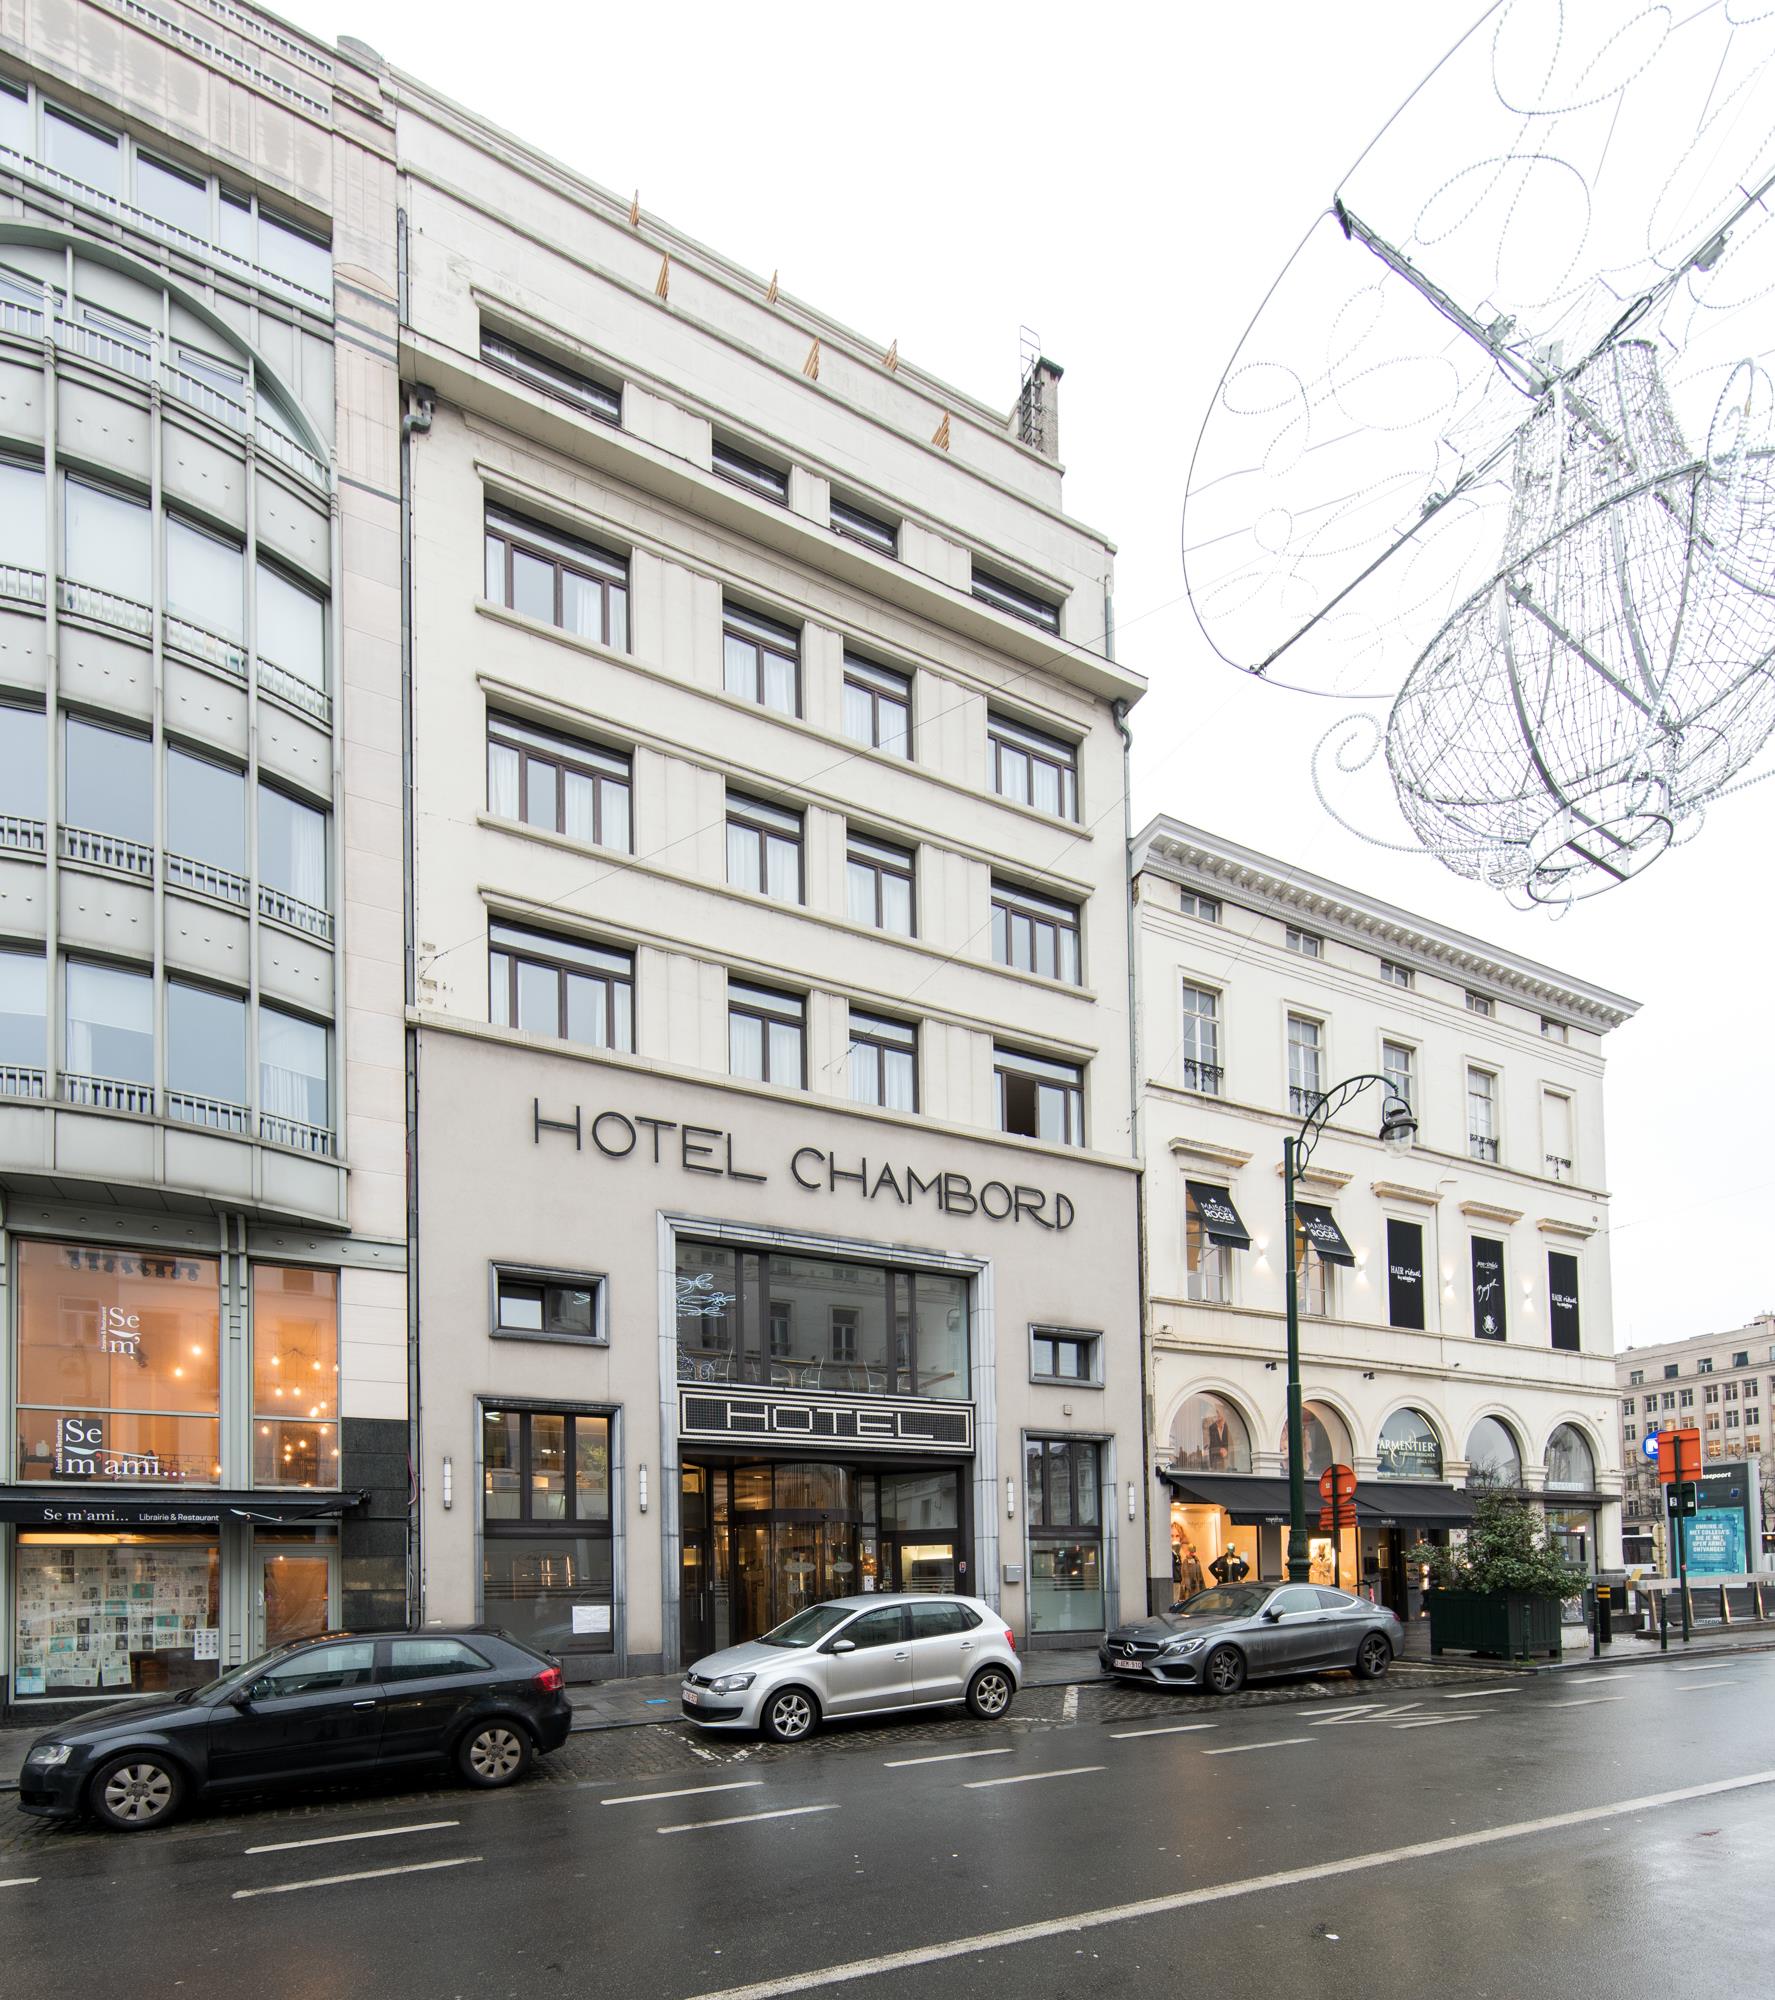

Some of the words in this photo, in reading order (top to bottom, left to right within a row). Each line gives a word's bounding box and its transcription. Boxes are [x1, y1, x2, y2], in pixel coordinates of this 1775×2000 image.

[534, 1097, 767, 1182] HOTEL
[791, 1147, 1075, 1230] CHAMBORD
[1200, 1202, 1232, 1214] MAISON
[1204, 1209, 1236, 1222] ROGER
[1306, 1222, 1336, 1234] MAISON
[1310, 1229, 1340, 1241] ROGER
[1390, 1265, 1404, 1275] HAIR
[1551, 1292, 1563, 1302] HAIR
[109, 1307, 140, 1328] Se
[727, 1402, 934, 1438] HOTEL
[65, 1419, 102, 1443] Se
[65, 1453, 186, 1476] m'ami...
[43, 1508, 62, 1521] Se
[67, 1509, 129, 1521] m'ami...
[139, 1513, 170, 1521] Librairie
[170, 1513, 177, 1521] &
[177, 1513, 220, 1522] Restaurant
